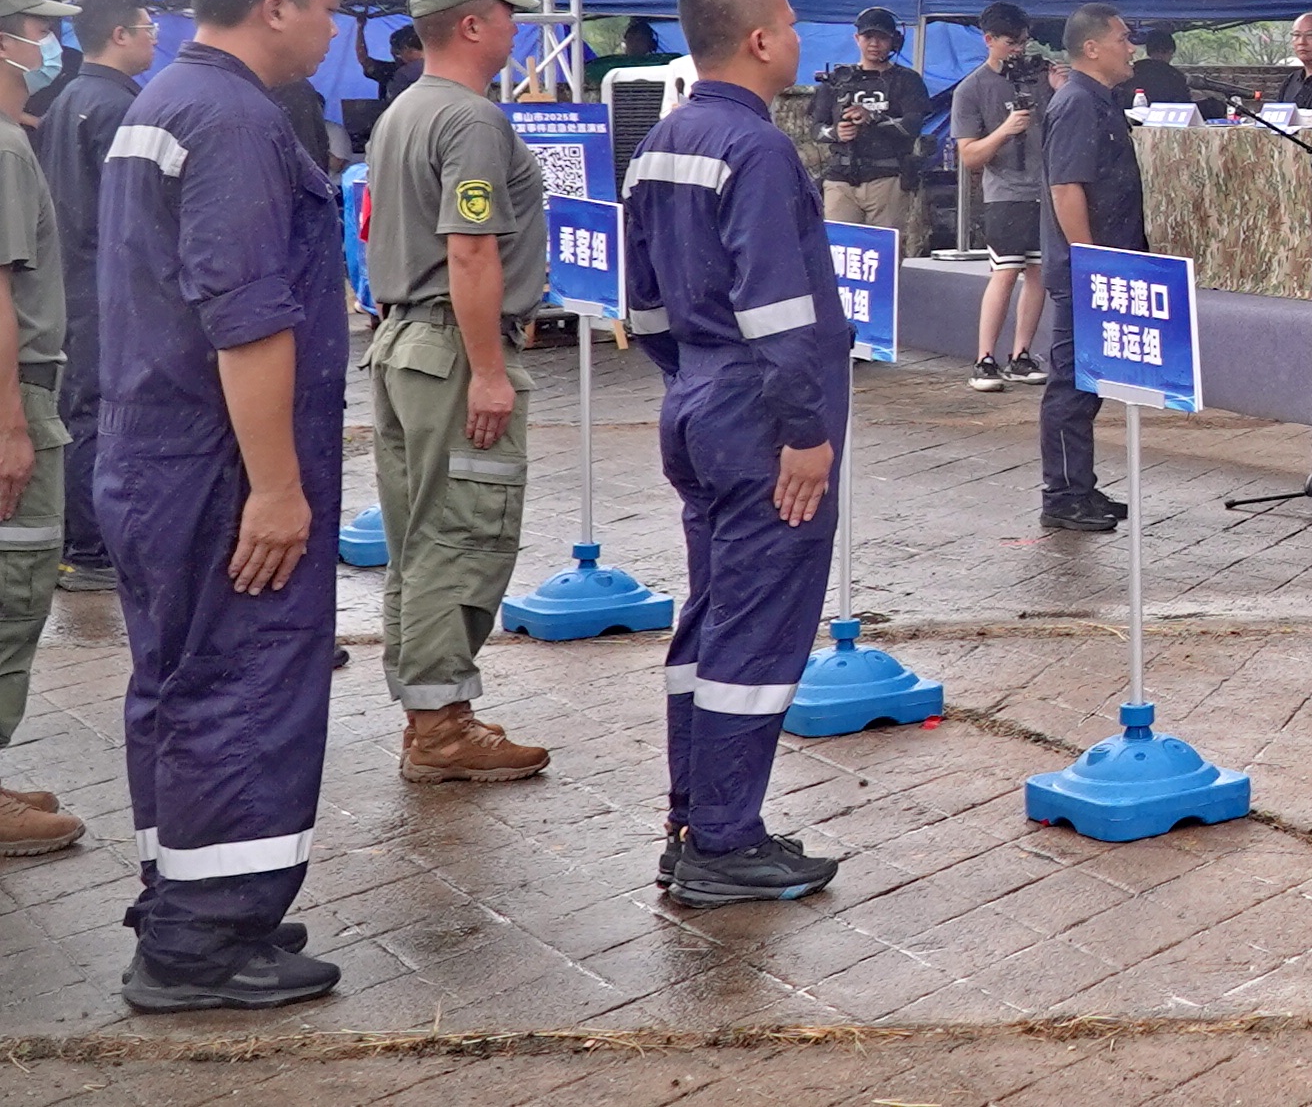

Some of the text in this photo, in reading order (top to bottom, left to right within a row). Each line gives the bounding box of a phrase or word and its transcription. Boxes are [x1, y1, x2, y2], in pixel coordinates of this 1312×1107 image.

[559, 226, 608, 271] 乘客组
[1090, 273, 1170, 320] 海寿渡口
[1102, 321, 1163, 366] 渡运组
